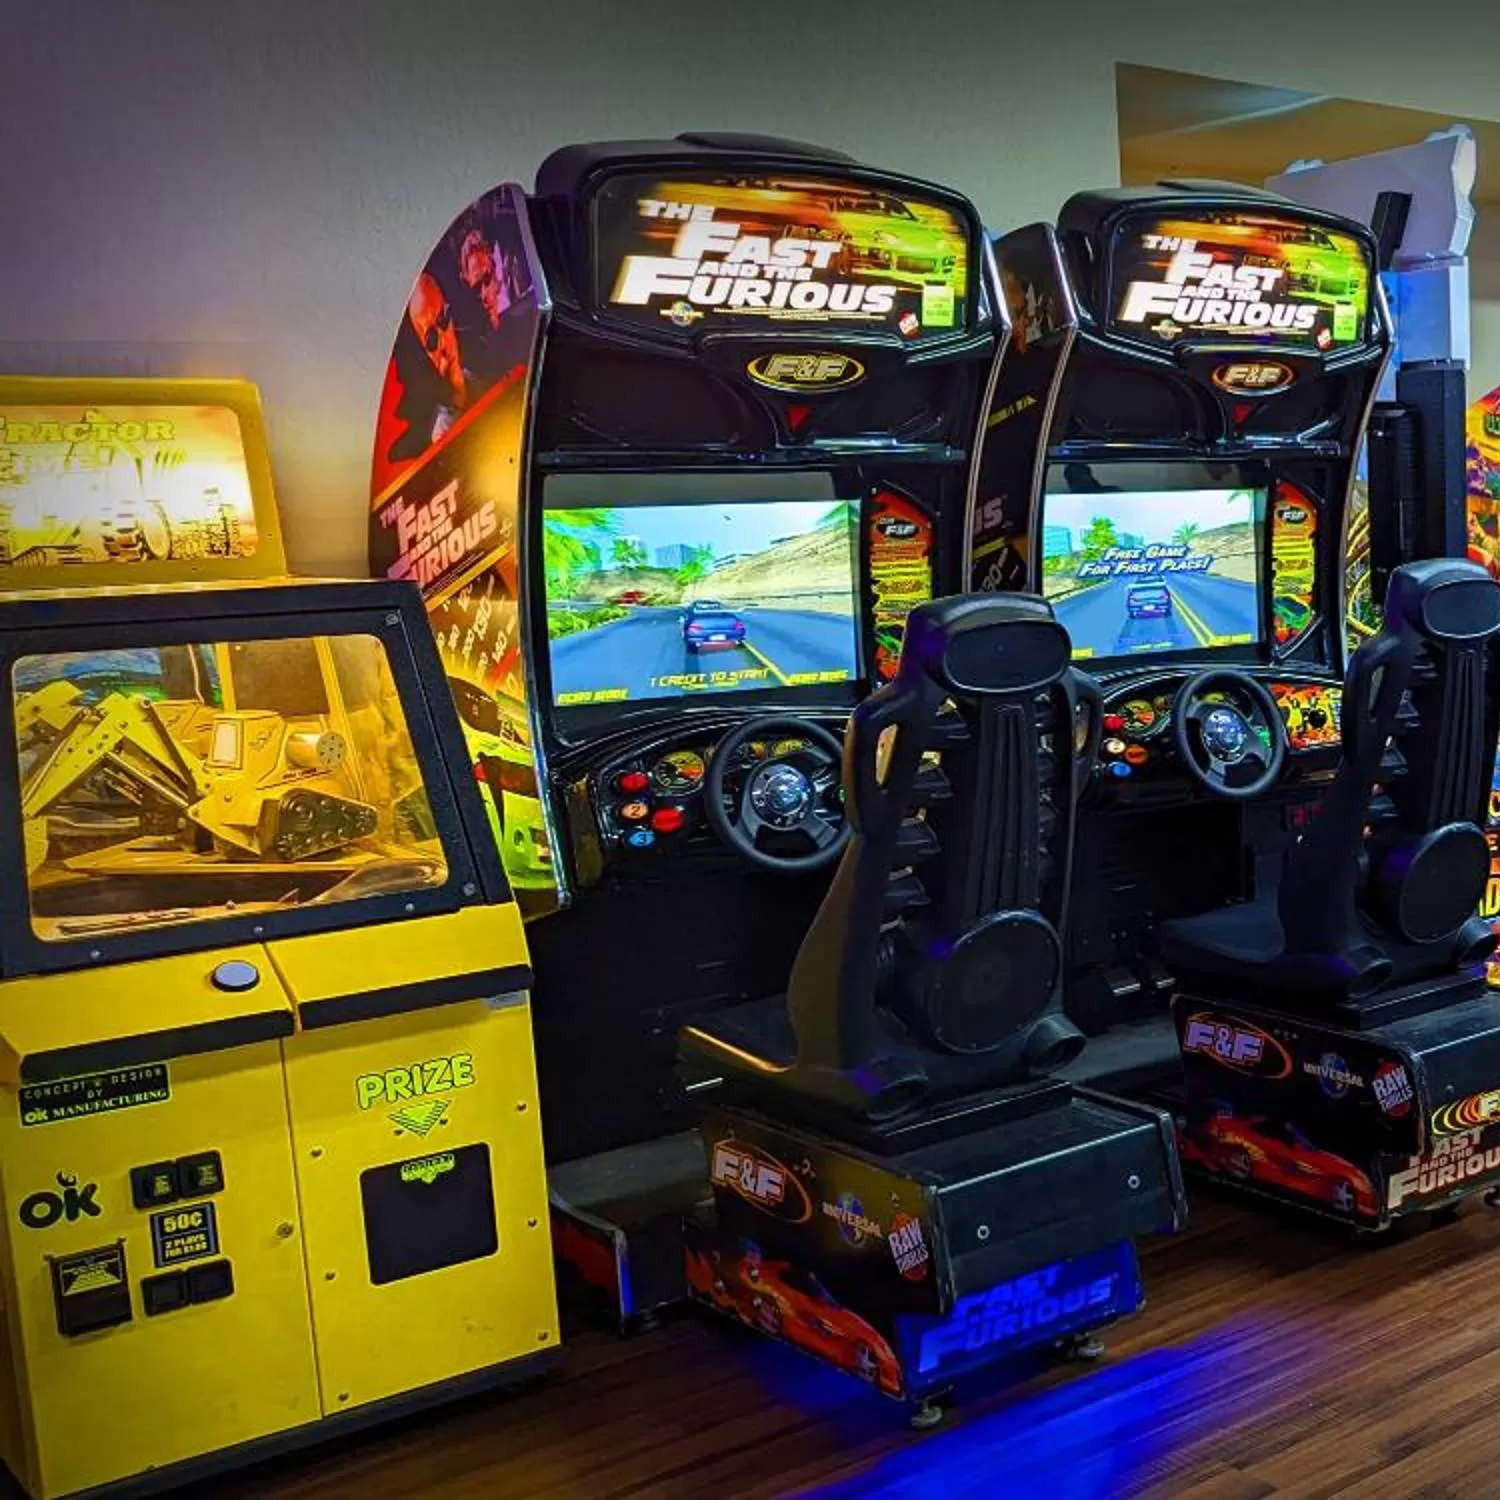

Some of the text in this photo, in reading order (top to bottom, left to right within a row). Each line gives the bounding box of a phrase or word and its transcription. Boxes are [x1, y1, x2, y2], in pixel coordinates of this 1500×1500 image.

[637, 199, 715, 223] THE
[671, 221, 843, 268] FAST
[1144, 234, 1198, 253] THE
[611, 254, 897, 312] FURIOUS
[699, 261, 813, 281] AND THE
[1164, 250, 1285, 291] FAST
[1119, 281, 1319, 328] FURIOUS
[1179, 285, 1262, 301] AND THE
[763, 354, 849, 383] F&F
[1224, 363, 1282, 386] F&F
[379, 495, 407, 529] THE
[396, 479, 460, 552] FAST
[1144, 545, 1188, 559] GAME
[1078, 562, 1111, 577] FOR
[1113, 561, 1158, 575] FIRST
[658, 672, 706, 688] CREDIT
[1184, 1021, 1263, 1062] F&F
[24, 1081, 85, 1099] CONCEPT
[111, 1067, 163, 1085] DESIGN
[87, 1089, 103, 1099] BY
[356, 1052, 476, 1111] PRIZE
[1372, 1065, 1410, 1098] RAW
[52, 1088, 167, 1118] MANUFACTURING
[1409, 1126, 1484, 1168] AST
[712, 1148, 787, 1206] F&F
[1421, 1157, 1449, 1173] AND
[887, 1217, 926, 1257] RAW
[918, 1272, 1117, 1374] FURIOUS
